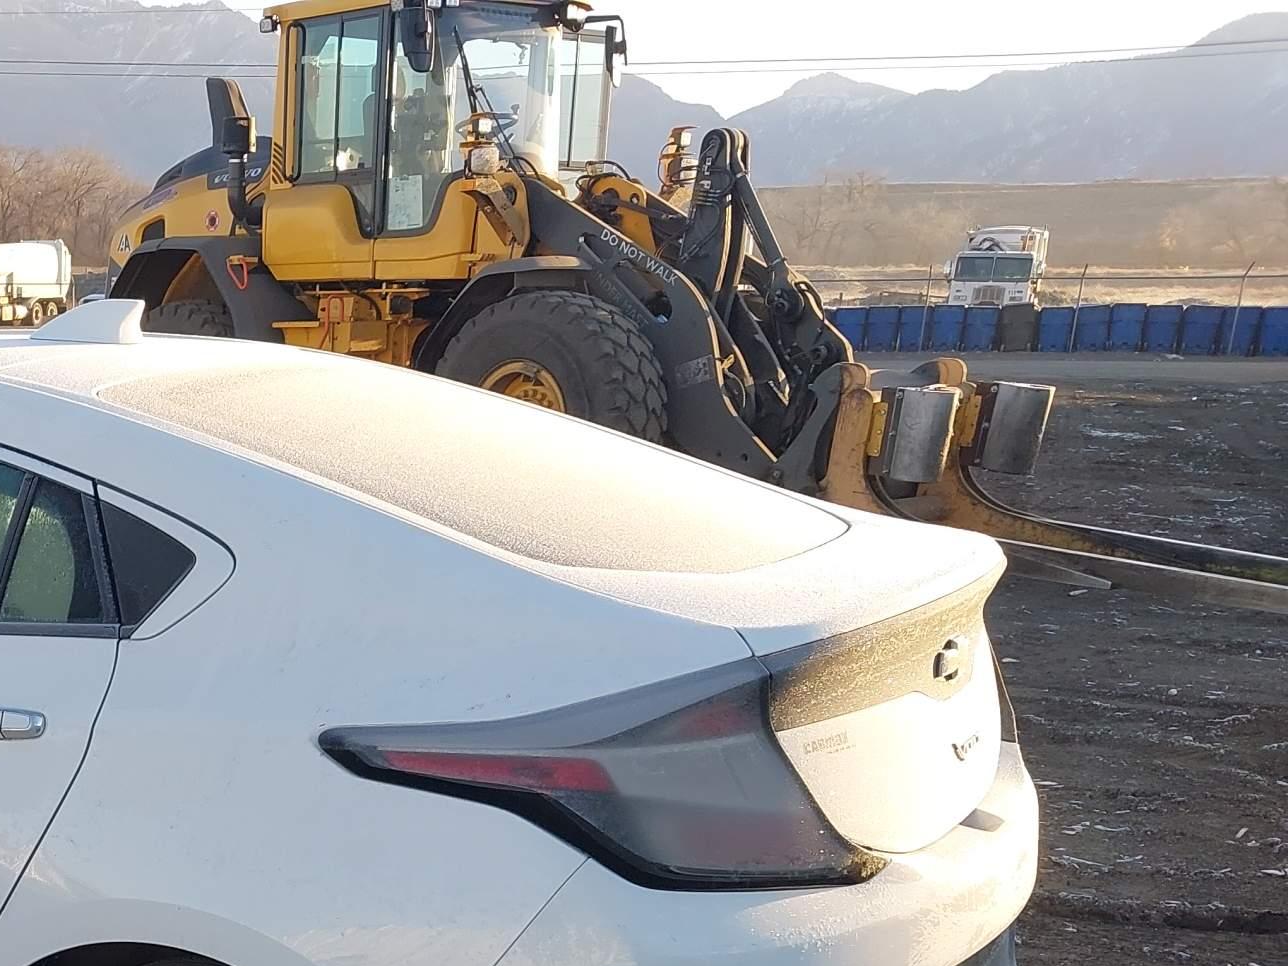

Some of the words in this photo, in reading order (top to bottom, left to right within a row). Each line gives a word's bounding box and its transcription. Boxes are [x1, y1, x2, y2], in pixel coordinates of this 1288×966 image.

[214, 168, 262, 184] VOVO
[600, 229, 617, 246] DO
[619, 241, 645, 263] NOT
[645, 256, 678, 287] WALK
